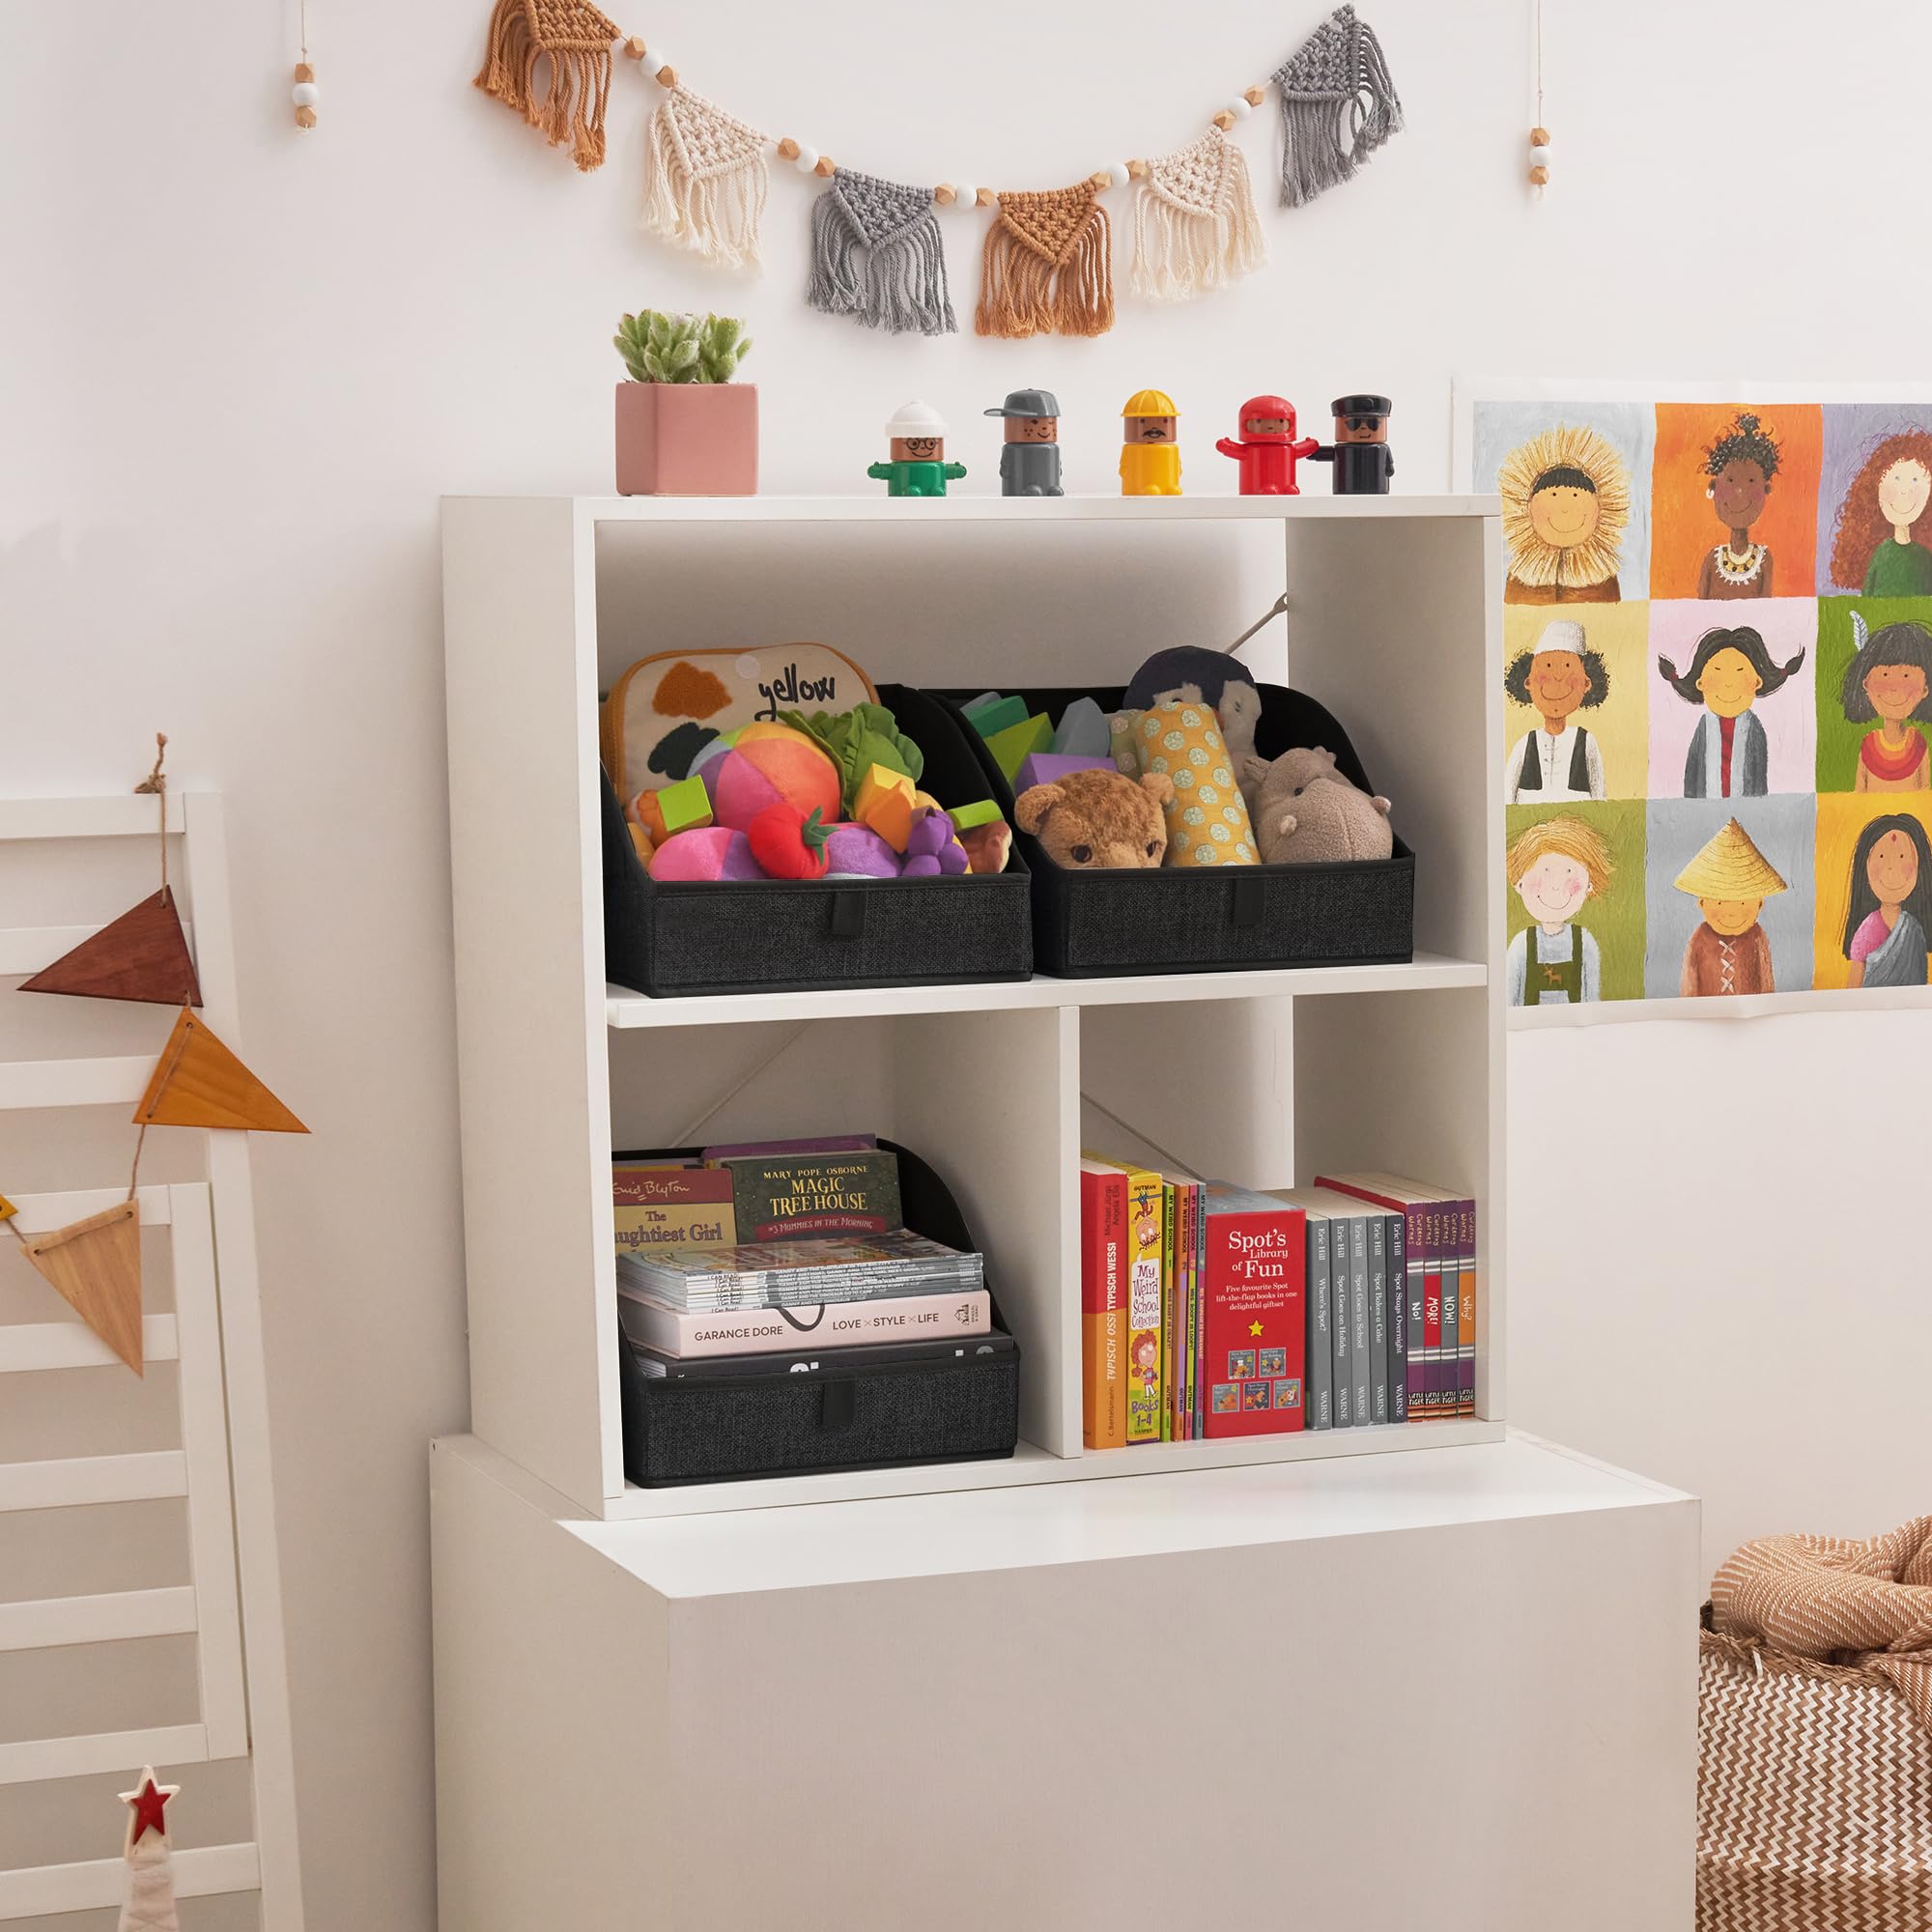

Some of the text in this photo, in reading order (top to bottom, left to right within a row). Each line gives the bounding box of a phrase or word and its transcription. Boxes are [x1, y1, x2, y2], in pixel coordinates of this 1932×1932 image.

[754, 663, 835, 722] yellow
[763, 1165, 869, 1179] MARY POPE OSBORNE
[643, 1180, 690, 1197] Blyton
[791, 1177, 845, 1195] MAGIC
[770, 1192, 868, 1217] TREE HOUSE
[1169, 1194, 1174, 1205] MY
[1182, 1198, 1188, 1207] MY
[1191, 1195, 1196, 1205] MY
[1201, 1194, 1206, 1204] MY
[645, 1210, 667, 1221] The
[690, 1222, 723, 1241] Girl
[1229, 1229, 1287, 1252] Spot's
[1250, 1249, 1289, 1259] Library
[1106, 1242, 1117, 1311] TYPISCH WESSI
[1138, 1264, 1155, 1278] My
[1232, 1260, 1285, 1279] of Fun
[1132, 1278, 1159, 1296] Weird
[1133, 1296, 1159, 1315] School
[1216, 1293, 1256, 1302] lift-the-flap
[1264, 1301, 1284, 1310] giftset
[1412, 1301, 1421, 1321] No!
[1427, 1296, 1439, 1325] MORE!
[1444, 1295, 1455, 1324] NOW!
[1461, 1295, 1474, 1321] Why?
[833, 1313, 939, 1330] LOVE STYLE LIFE
[1318, 1310, 1327, 1331] Spot?
[1339, 1315, 1344, 1325] on
[1356, 1314, 1362, 1322] to
[695, 1325, 783, 1341] GARANCE DORE
[1338, 1326, 1347, 1357] Holiday
[1132, 1400, 1159, 1414] Books
[1137, 1413, 1151, 1426] 1-4
